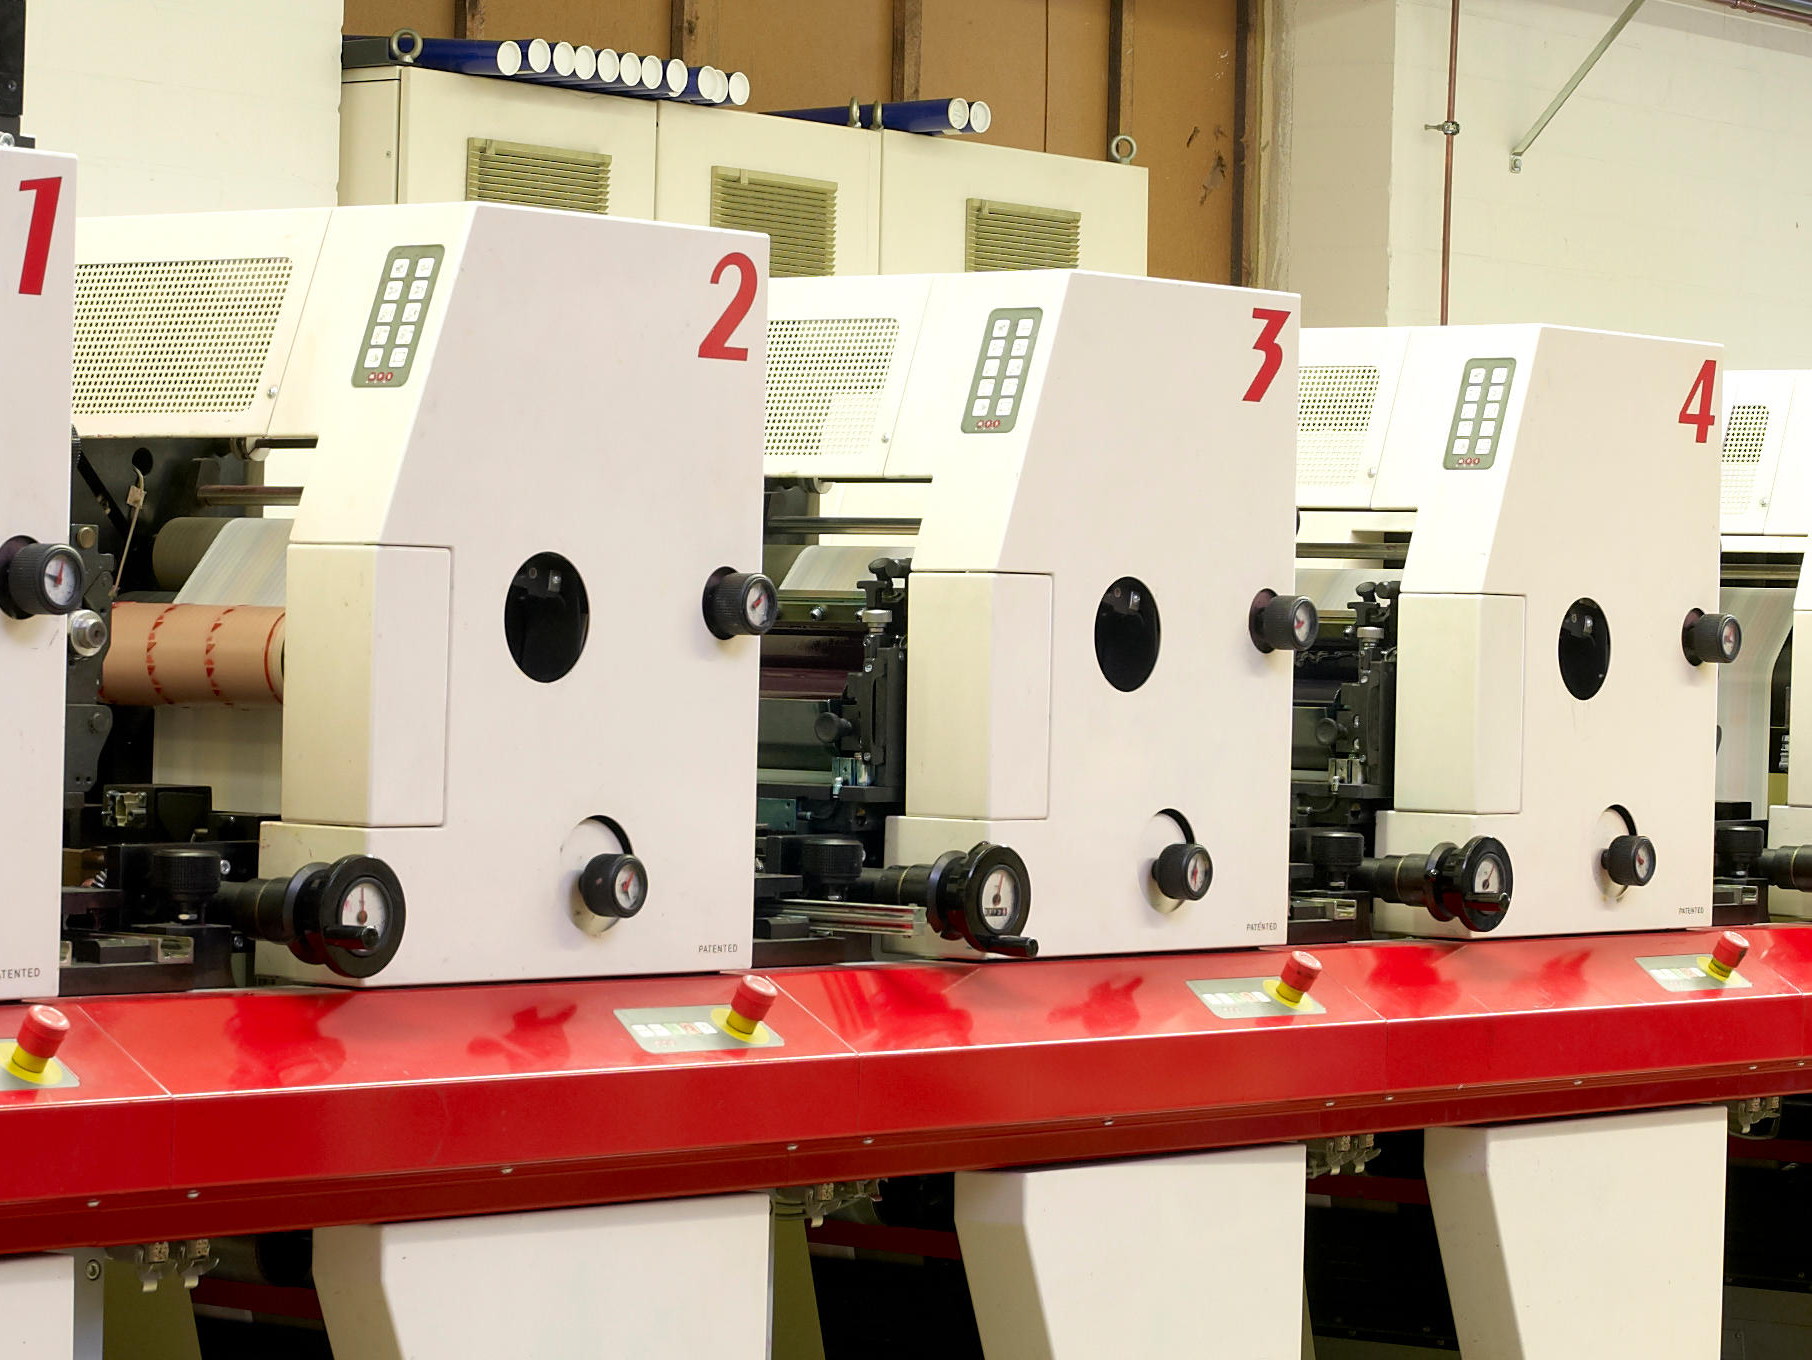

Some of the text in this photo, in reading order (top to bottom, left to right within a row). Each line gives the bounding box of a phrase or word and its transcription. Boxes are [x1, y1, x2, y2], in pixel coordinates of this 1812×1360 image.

[19, 176, 63, 296] 1
[698, 252, 759, 362] 2
[1243, 307, 1291, 403] 3
[1678, 359, 1717, 444] 4
[698, 943, 739, 954] PATENTED
[1246, 922, 1278, 932] PATENTED
